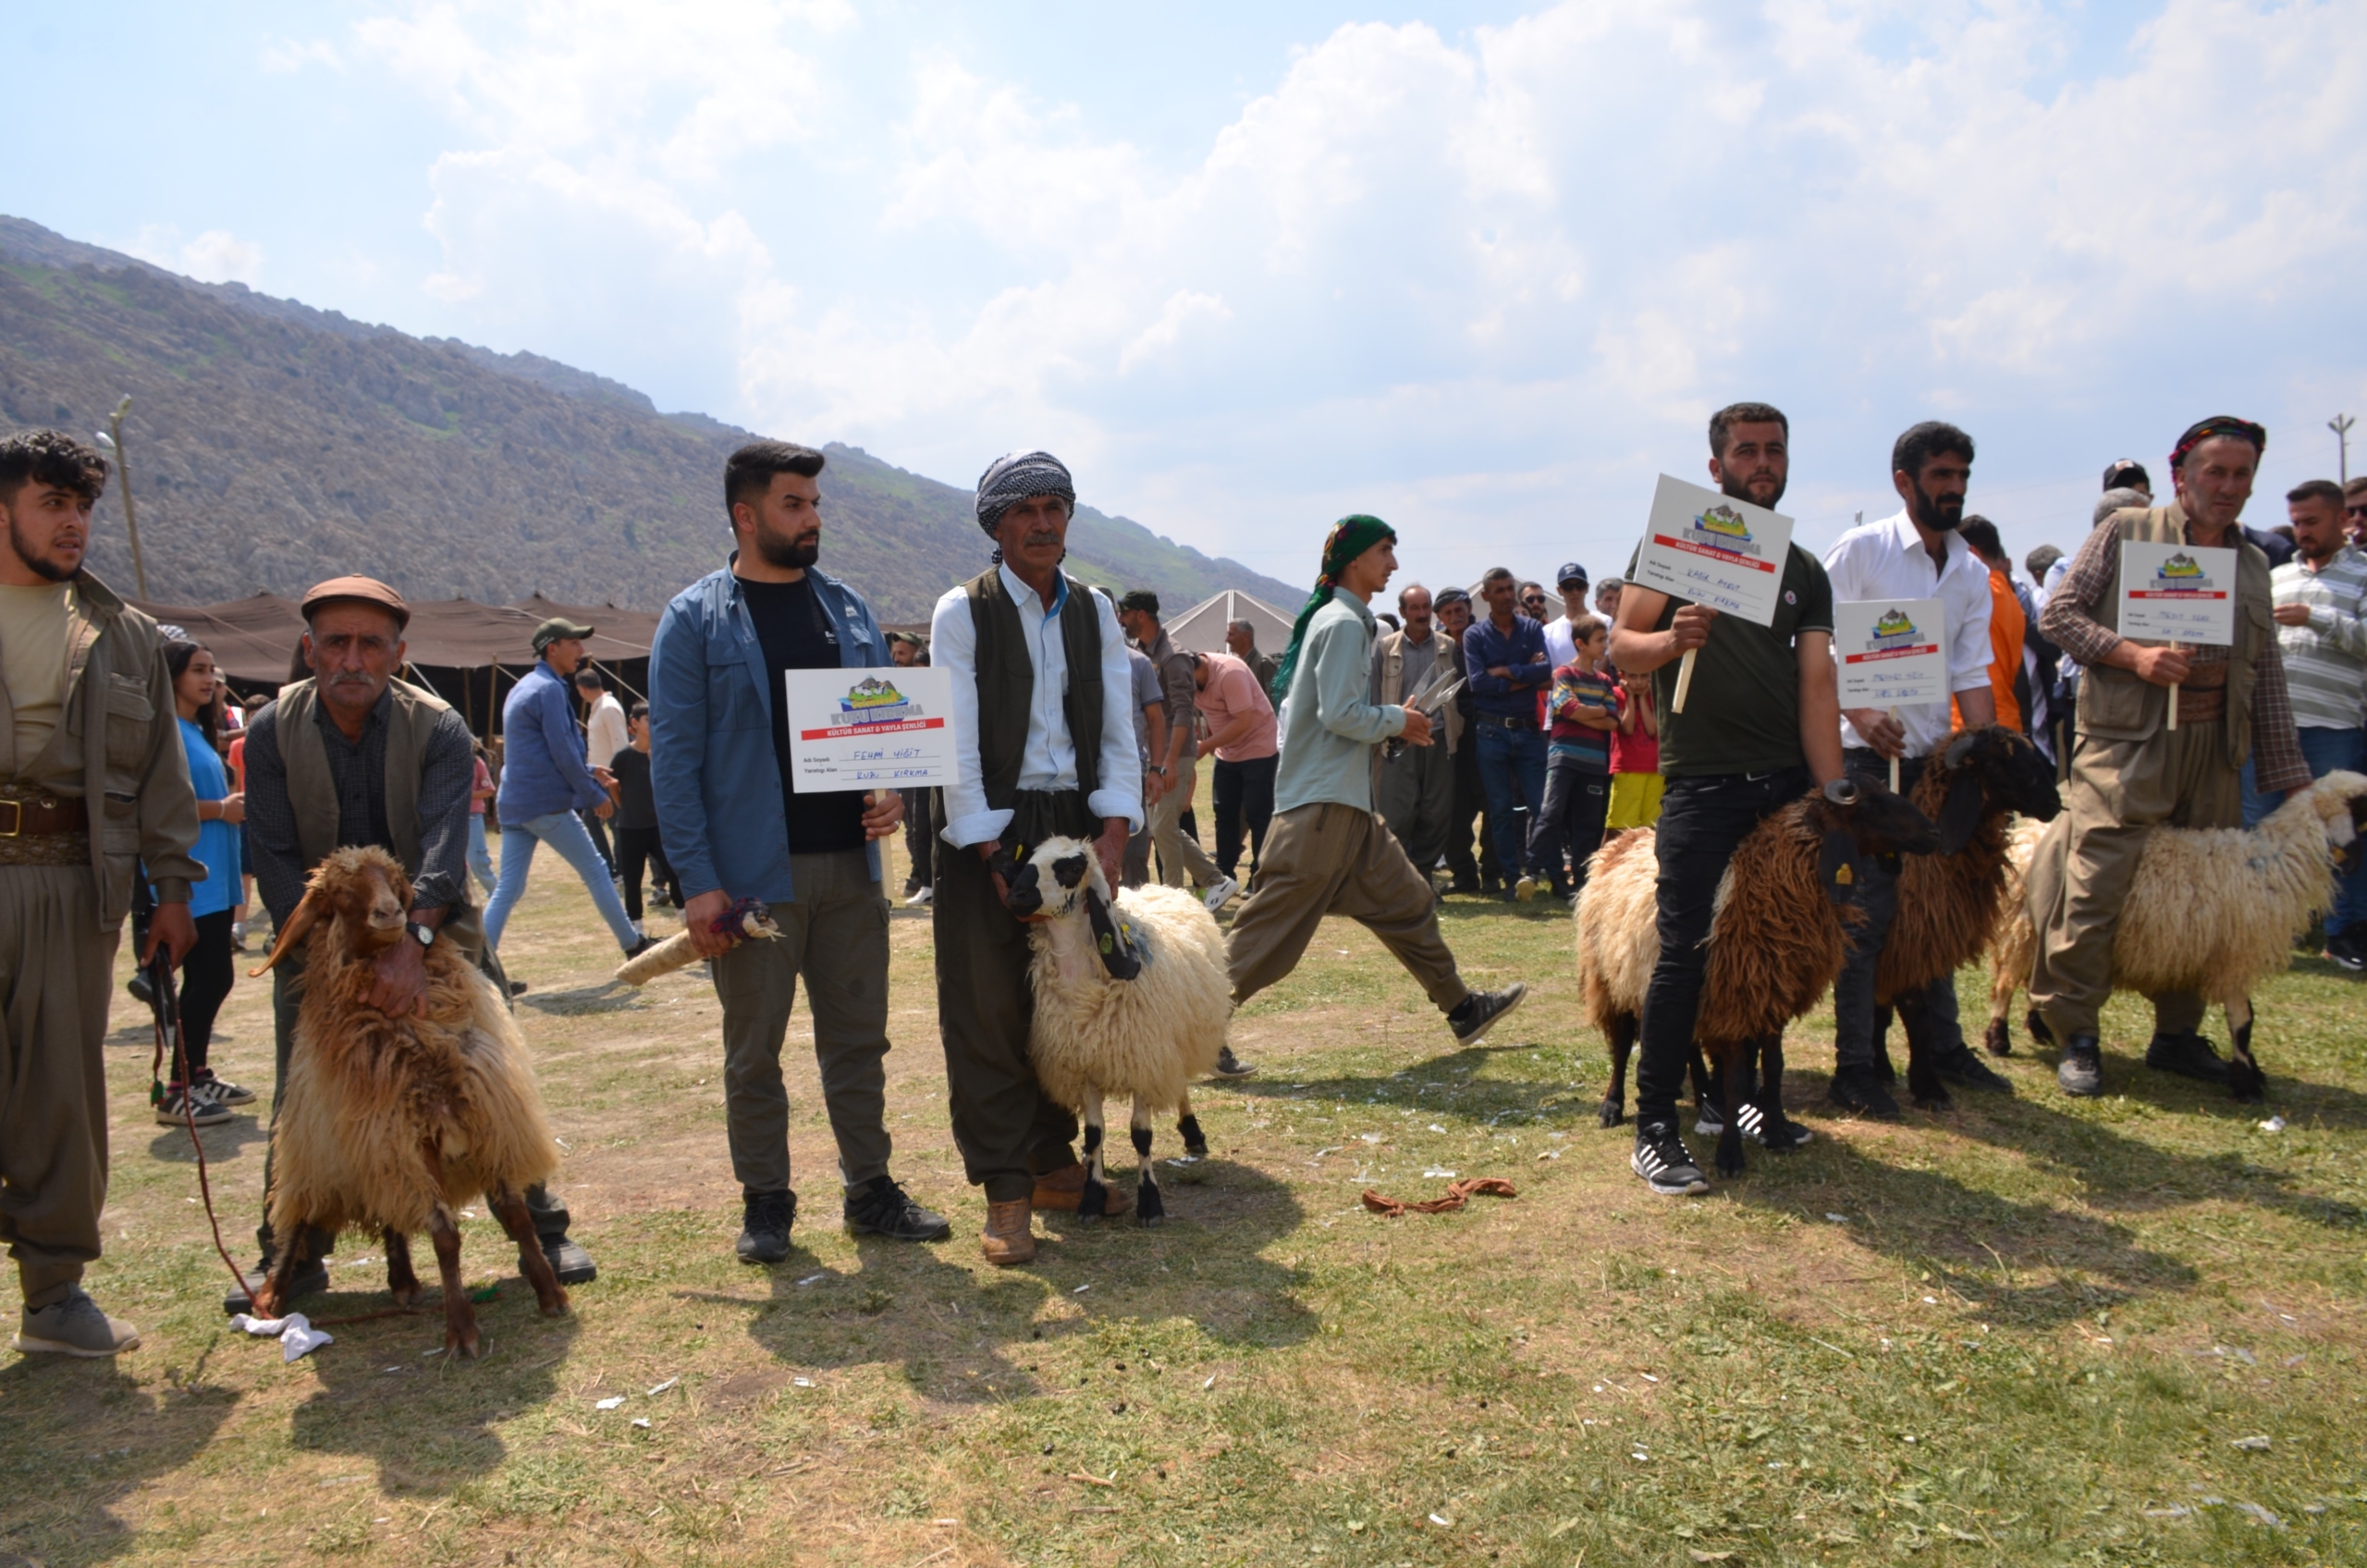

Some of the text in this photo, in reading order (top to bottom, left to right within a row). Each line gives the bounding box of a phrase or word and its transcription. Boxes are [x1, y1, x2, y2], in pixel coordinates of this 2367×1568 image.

[830, 704, 925, 726] KUZU KIRKMA
[827, 727, 852, 737] KÜLTÜR
[853, 726, 875, 735] SANAT
[881, 723, 901, 732] YAYLA
[902, 720, 926, 731] ŞENLİĞİ
[813, 756, 830, 765] Soyadı
[893, 769, 929, 778] KIRKMA
